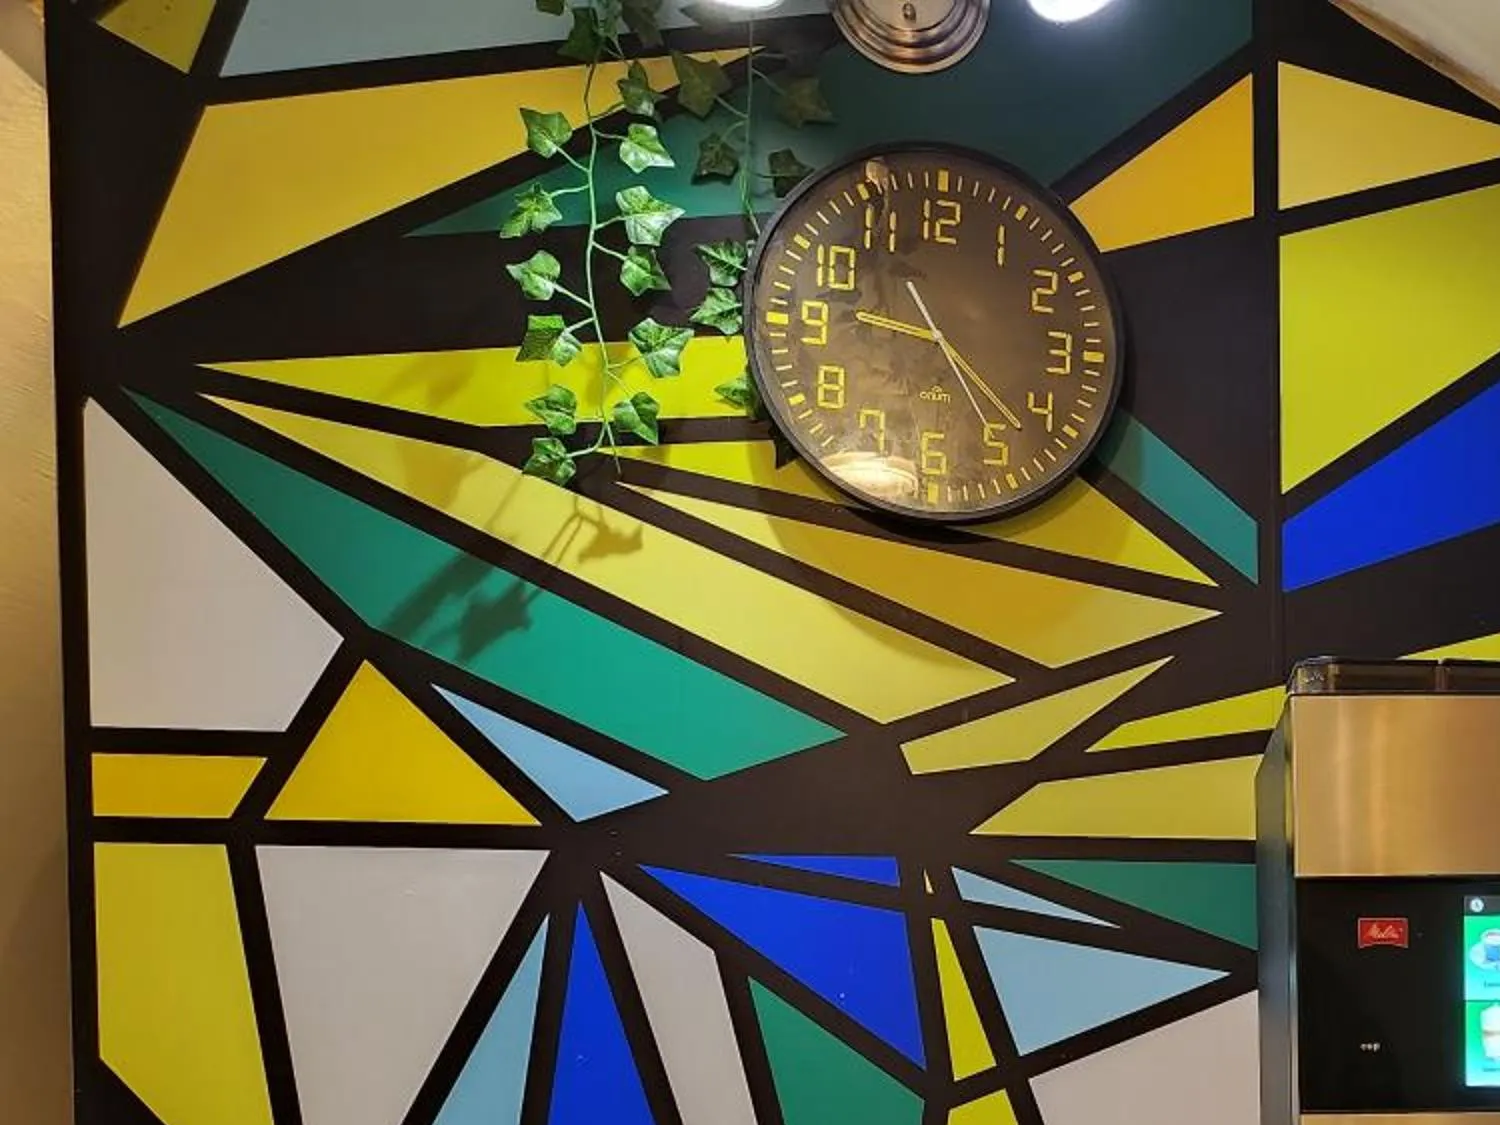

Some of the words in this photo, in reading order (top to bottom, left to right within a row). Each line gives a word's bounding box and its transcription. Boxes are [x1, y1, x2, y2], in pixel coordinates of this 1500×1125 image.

[864, 206, 897, 252] 11
[922, 200, 961, 245] 12
[817, 244, 857, 290] 10
[996, 224, 1006, 266] 1
[1031, 268, 1059, 314] 2
[801, 300, 829, 345] 9
[1045, 331, 1073, 375] 3
[817, 365, 846, 409] 8
[858, 409, 886, 451] 7
[1027, 391, 1054, 432] 4
[920, 431, 948, 475] 6
[983, 422, 1009, 467] 5
